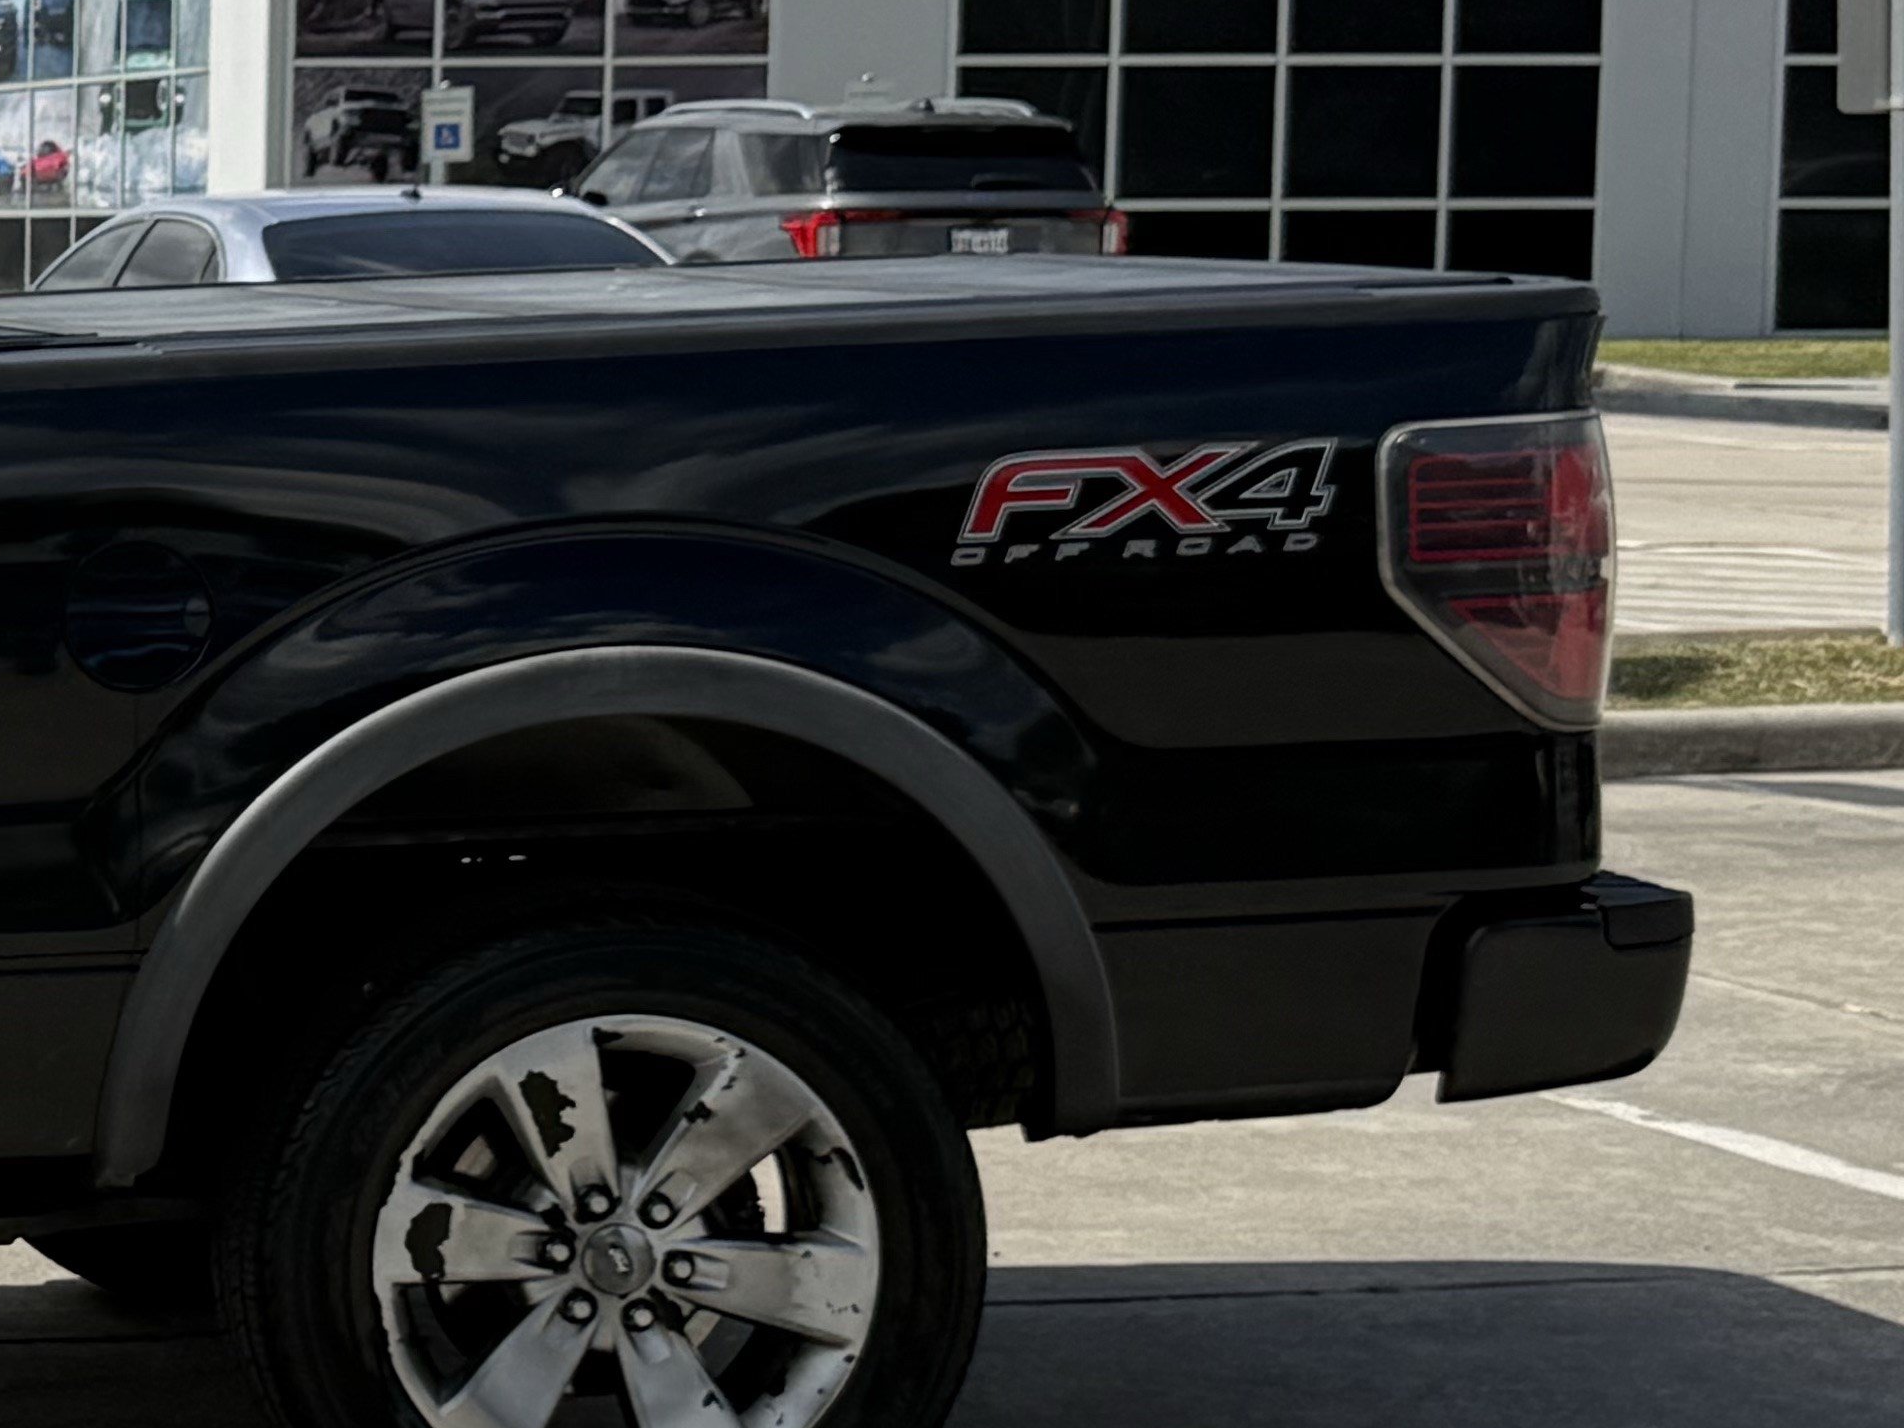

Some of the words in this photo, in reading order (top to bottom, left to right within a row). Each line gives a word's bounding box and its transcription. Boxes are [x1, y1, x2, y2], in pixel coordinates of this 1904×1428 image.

[956, 437, 1339, 543] FX4
[950, 540, 1092, 566] OFF
[1122, 532, 1321, 559] ROAD
